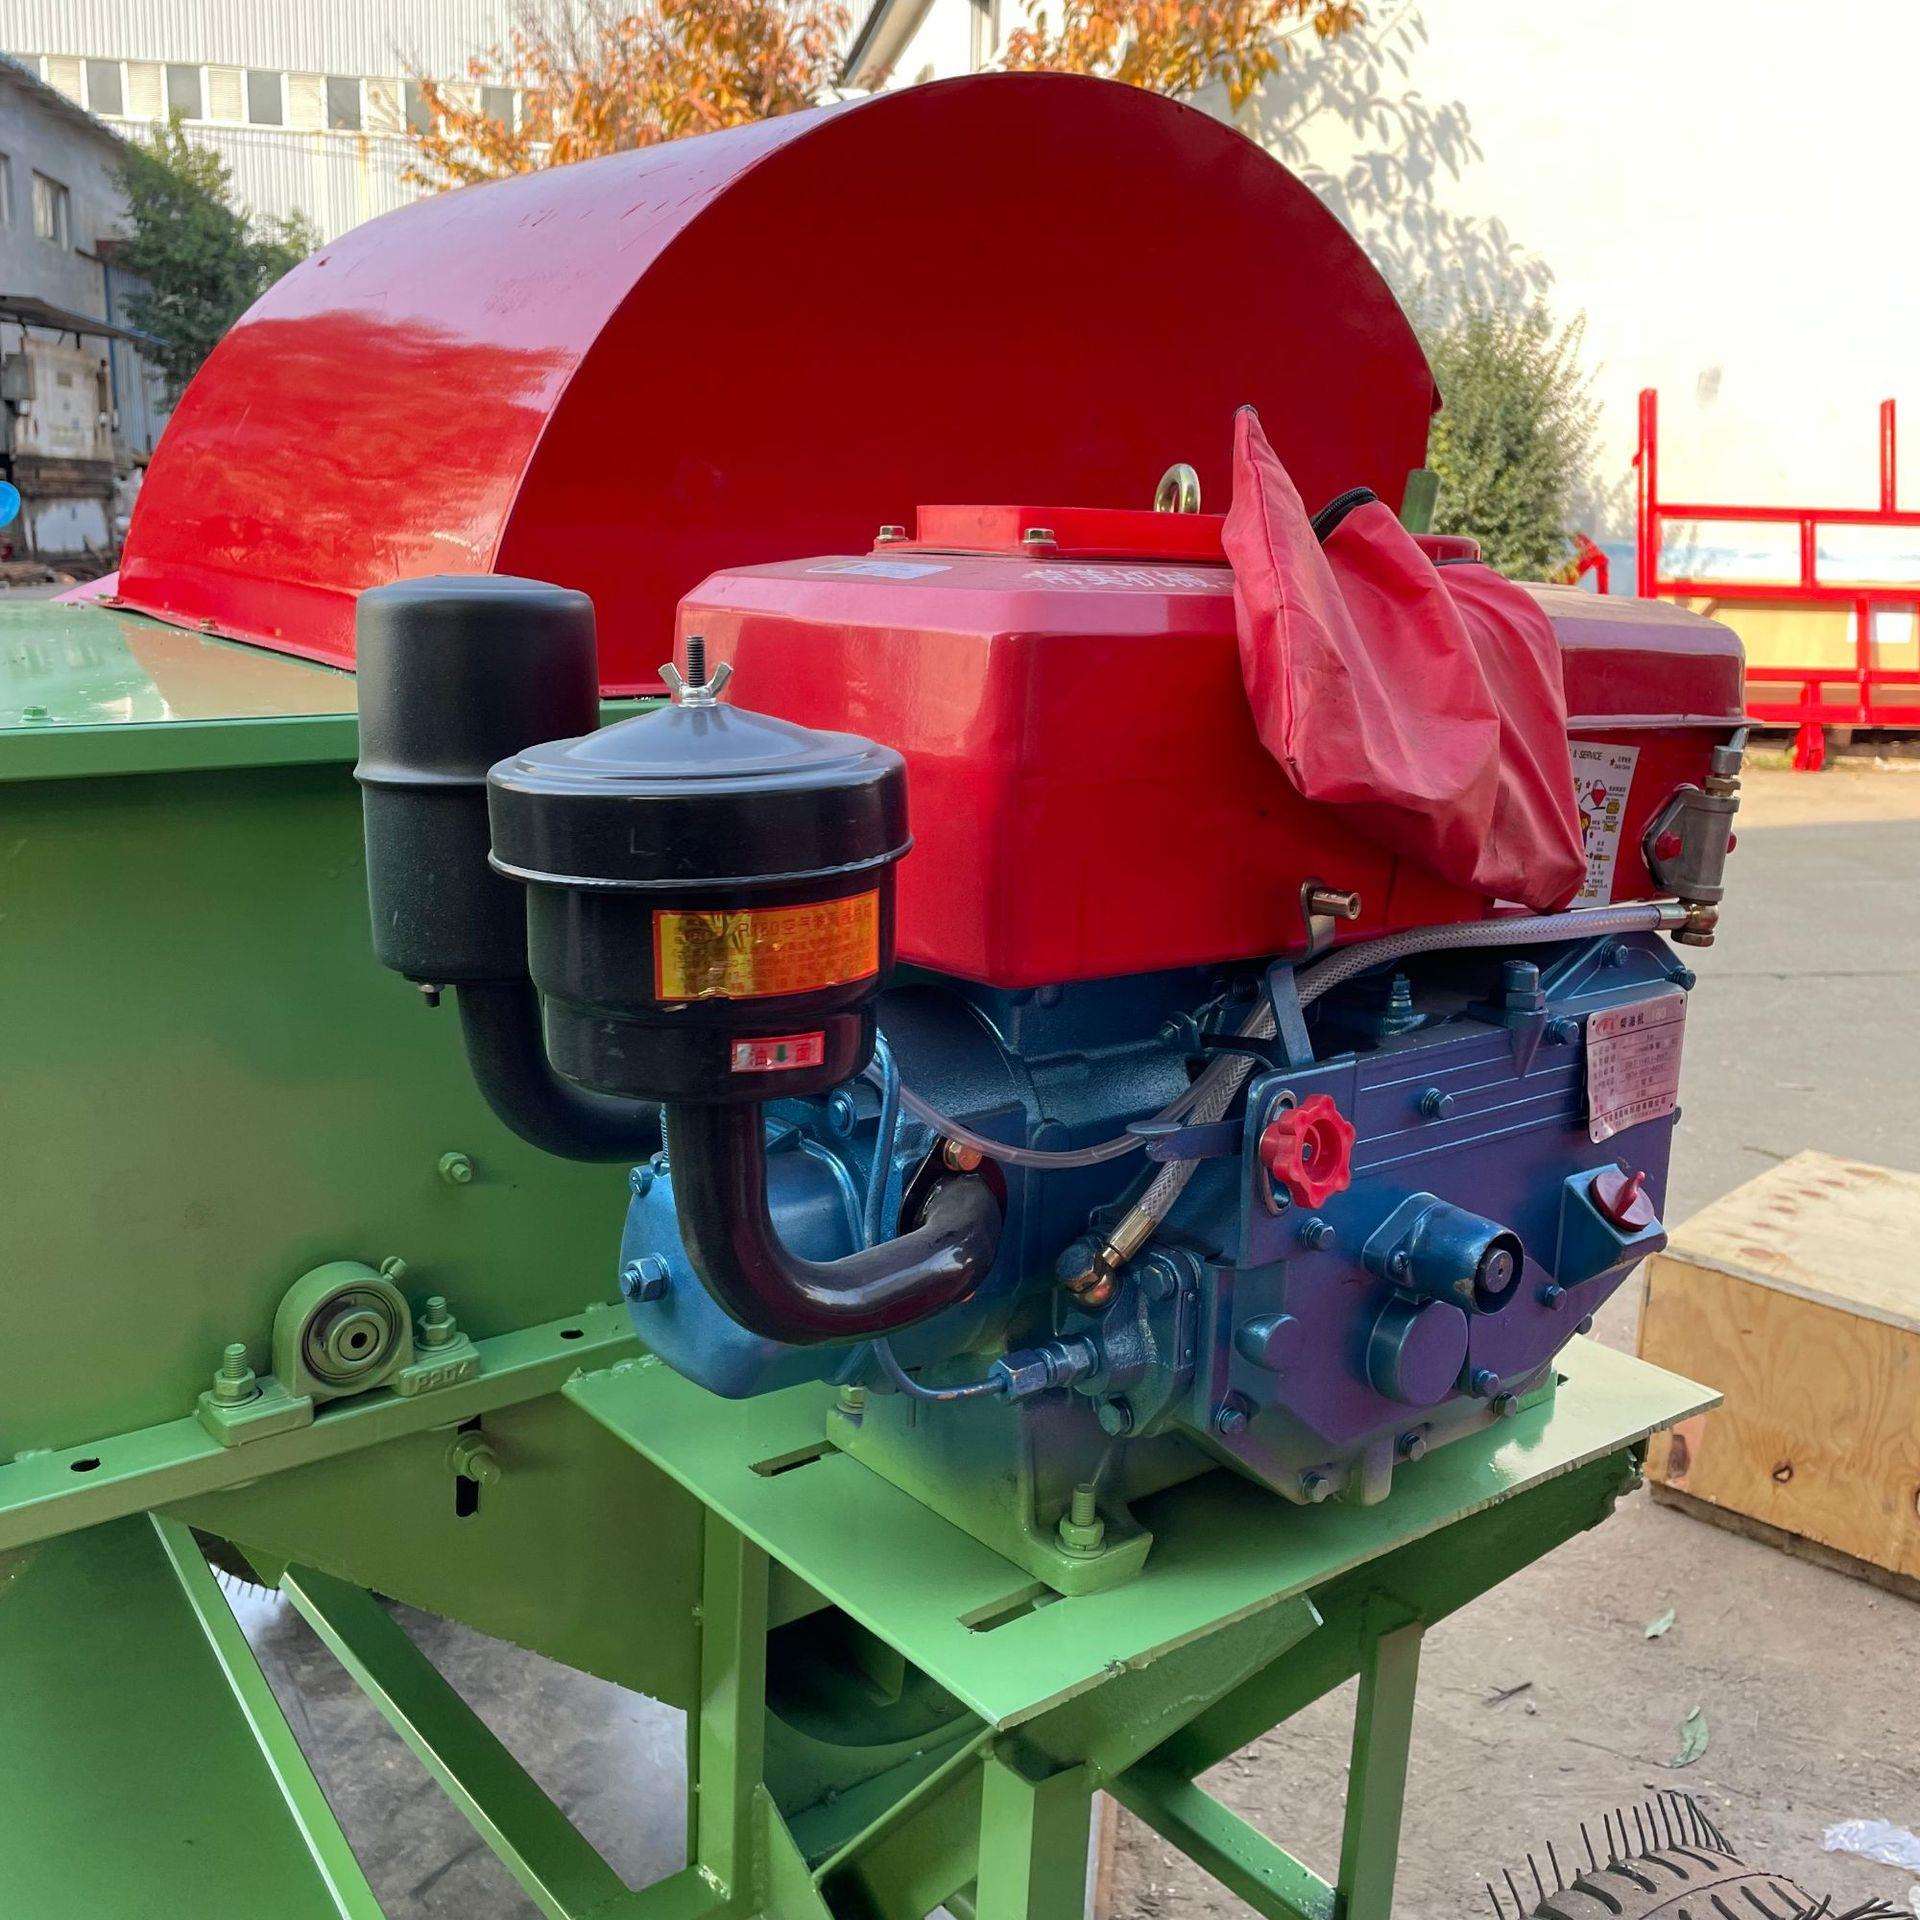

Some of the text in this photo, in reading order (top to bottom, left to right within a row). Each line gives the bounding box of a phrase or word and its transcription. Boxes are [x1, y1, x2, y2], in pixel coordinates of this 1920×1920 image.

[1578, 749, 1603, 761] SERVICE
[1620, 1012, 1644, 1028] 柴油机
